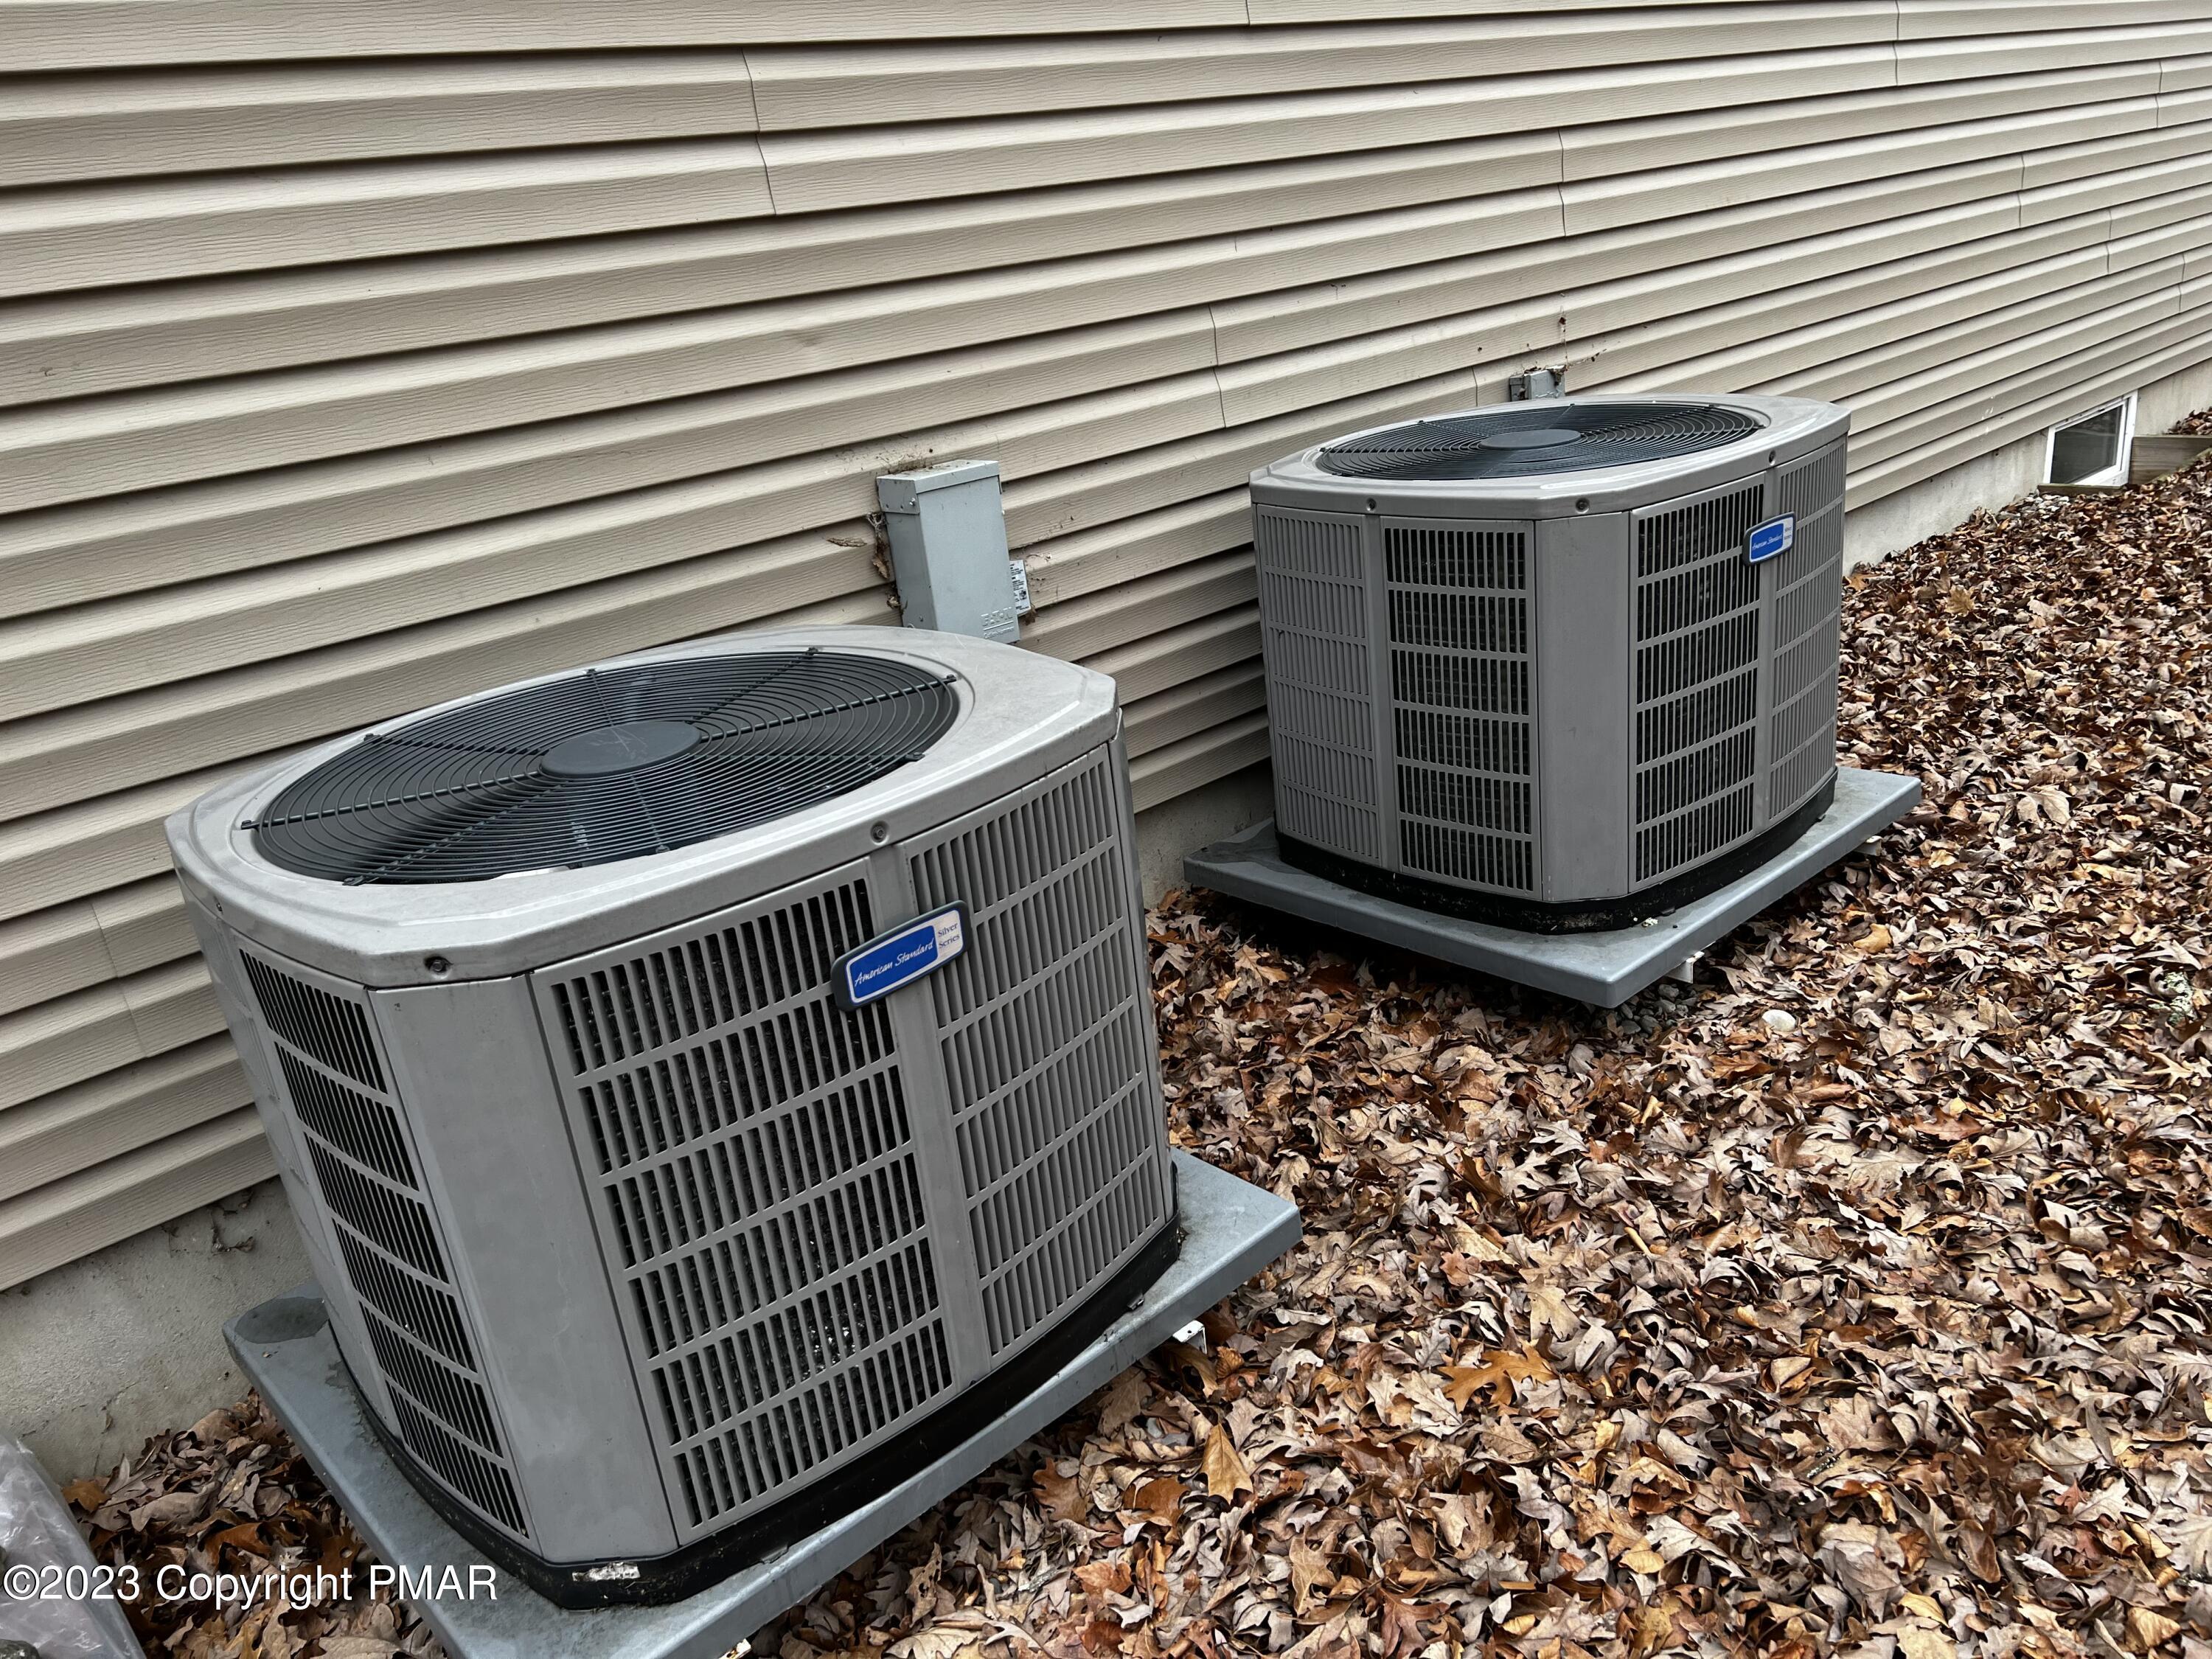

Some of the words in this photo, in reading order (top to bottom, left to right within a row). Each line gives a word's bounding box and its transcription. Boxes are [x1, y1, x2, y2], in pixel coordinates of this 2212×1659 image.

[937, 922, 958, 937] Silver
[939, 934, 960, 949] Series
[855, 961, 893, 987] American
[894, 937, 934, 967] Standard
